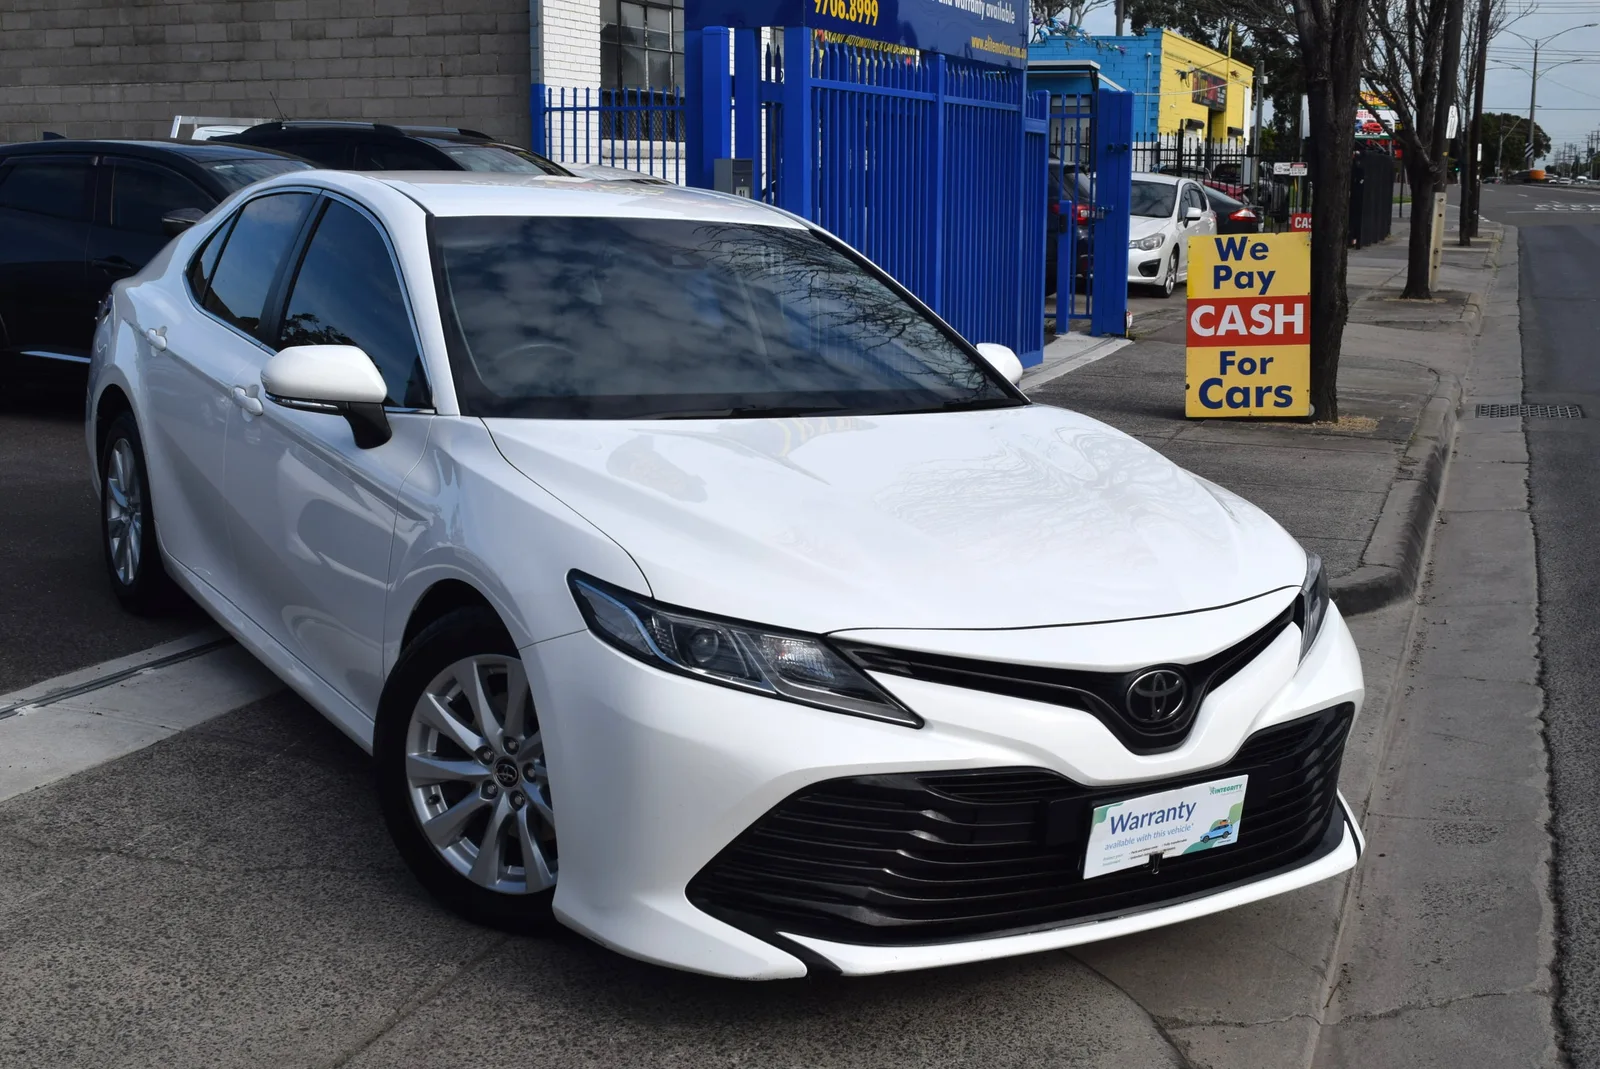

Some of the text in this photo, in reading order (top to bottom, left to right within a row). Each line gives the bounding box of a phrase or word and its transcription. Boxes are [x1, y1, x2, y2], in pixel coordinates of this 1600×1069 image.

[813, 0, 879, 26] 9706.8999
[986, 1, 1015, 24] available
[1214, 236, 1269, 261] We
[1213, 265, 1276, 295] Pay
[1190, 303, 1304, 337] CASH
[1219, 351, 1274, 375] For
[1198, 378, 1293, 409] Cars
[1214, 784, 1243, 795] INTEGRITY
[1110, 801, 1197, 835] Warranty
[1104, 837, 1135, 851] available
[1136, 832, 1152, 843] with
[1153, 828, 1166, 839] this
